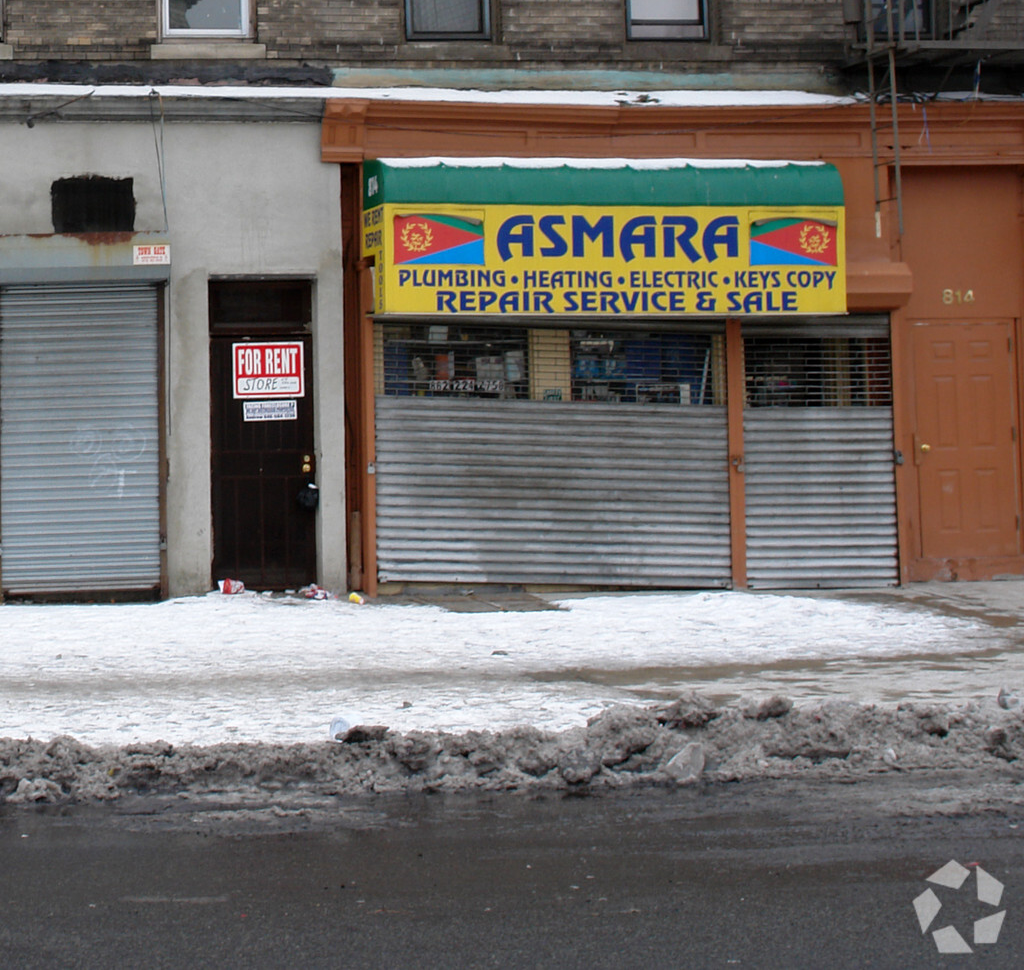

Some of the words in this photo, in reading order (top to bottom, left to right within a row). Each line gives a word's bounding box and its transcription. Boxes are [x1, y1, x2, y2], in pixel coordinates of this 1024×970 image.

[496, 215, 740, 263] ASMARA
[398, 270, 506, 287] PLUMBING
[524, 270, 612, 290] HEATING
[630, 270, 718, 290] ELECTRIC
[734, 270, 781, 290] KEYS
[786, 270, 836, 290] COPY
[436, 290, 555, 313] REPAIR
[563, 291, 686, 312] SERVICE
[695, 291, 717, 312] &
[726, 291, 798, 313] SALE
[942, 289, 974, 304] 814
[238, 348, 262, 375] FOR
[265, 348, 298, 374] RENT
[244, 378, 278, 390] STORE
